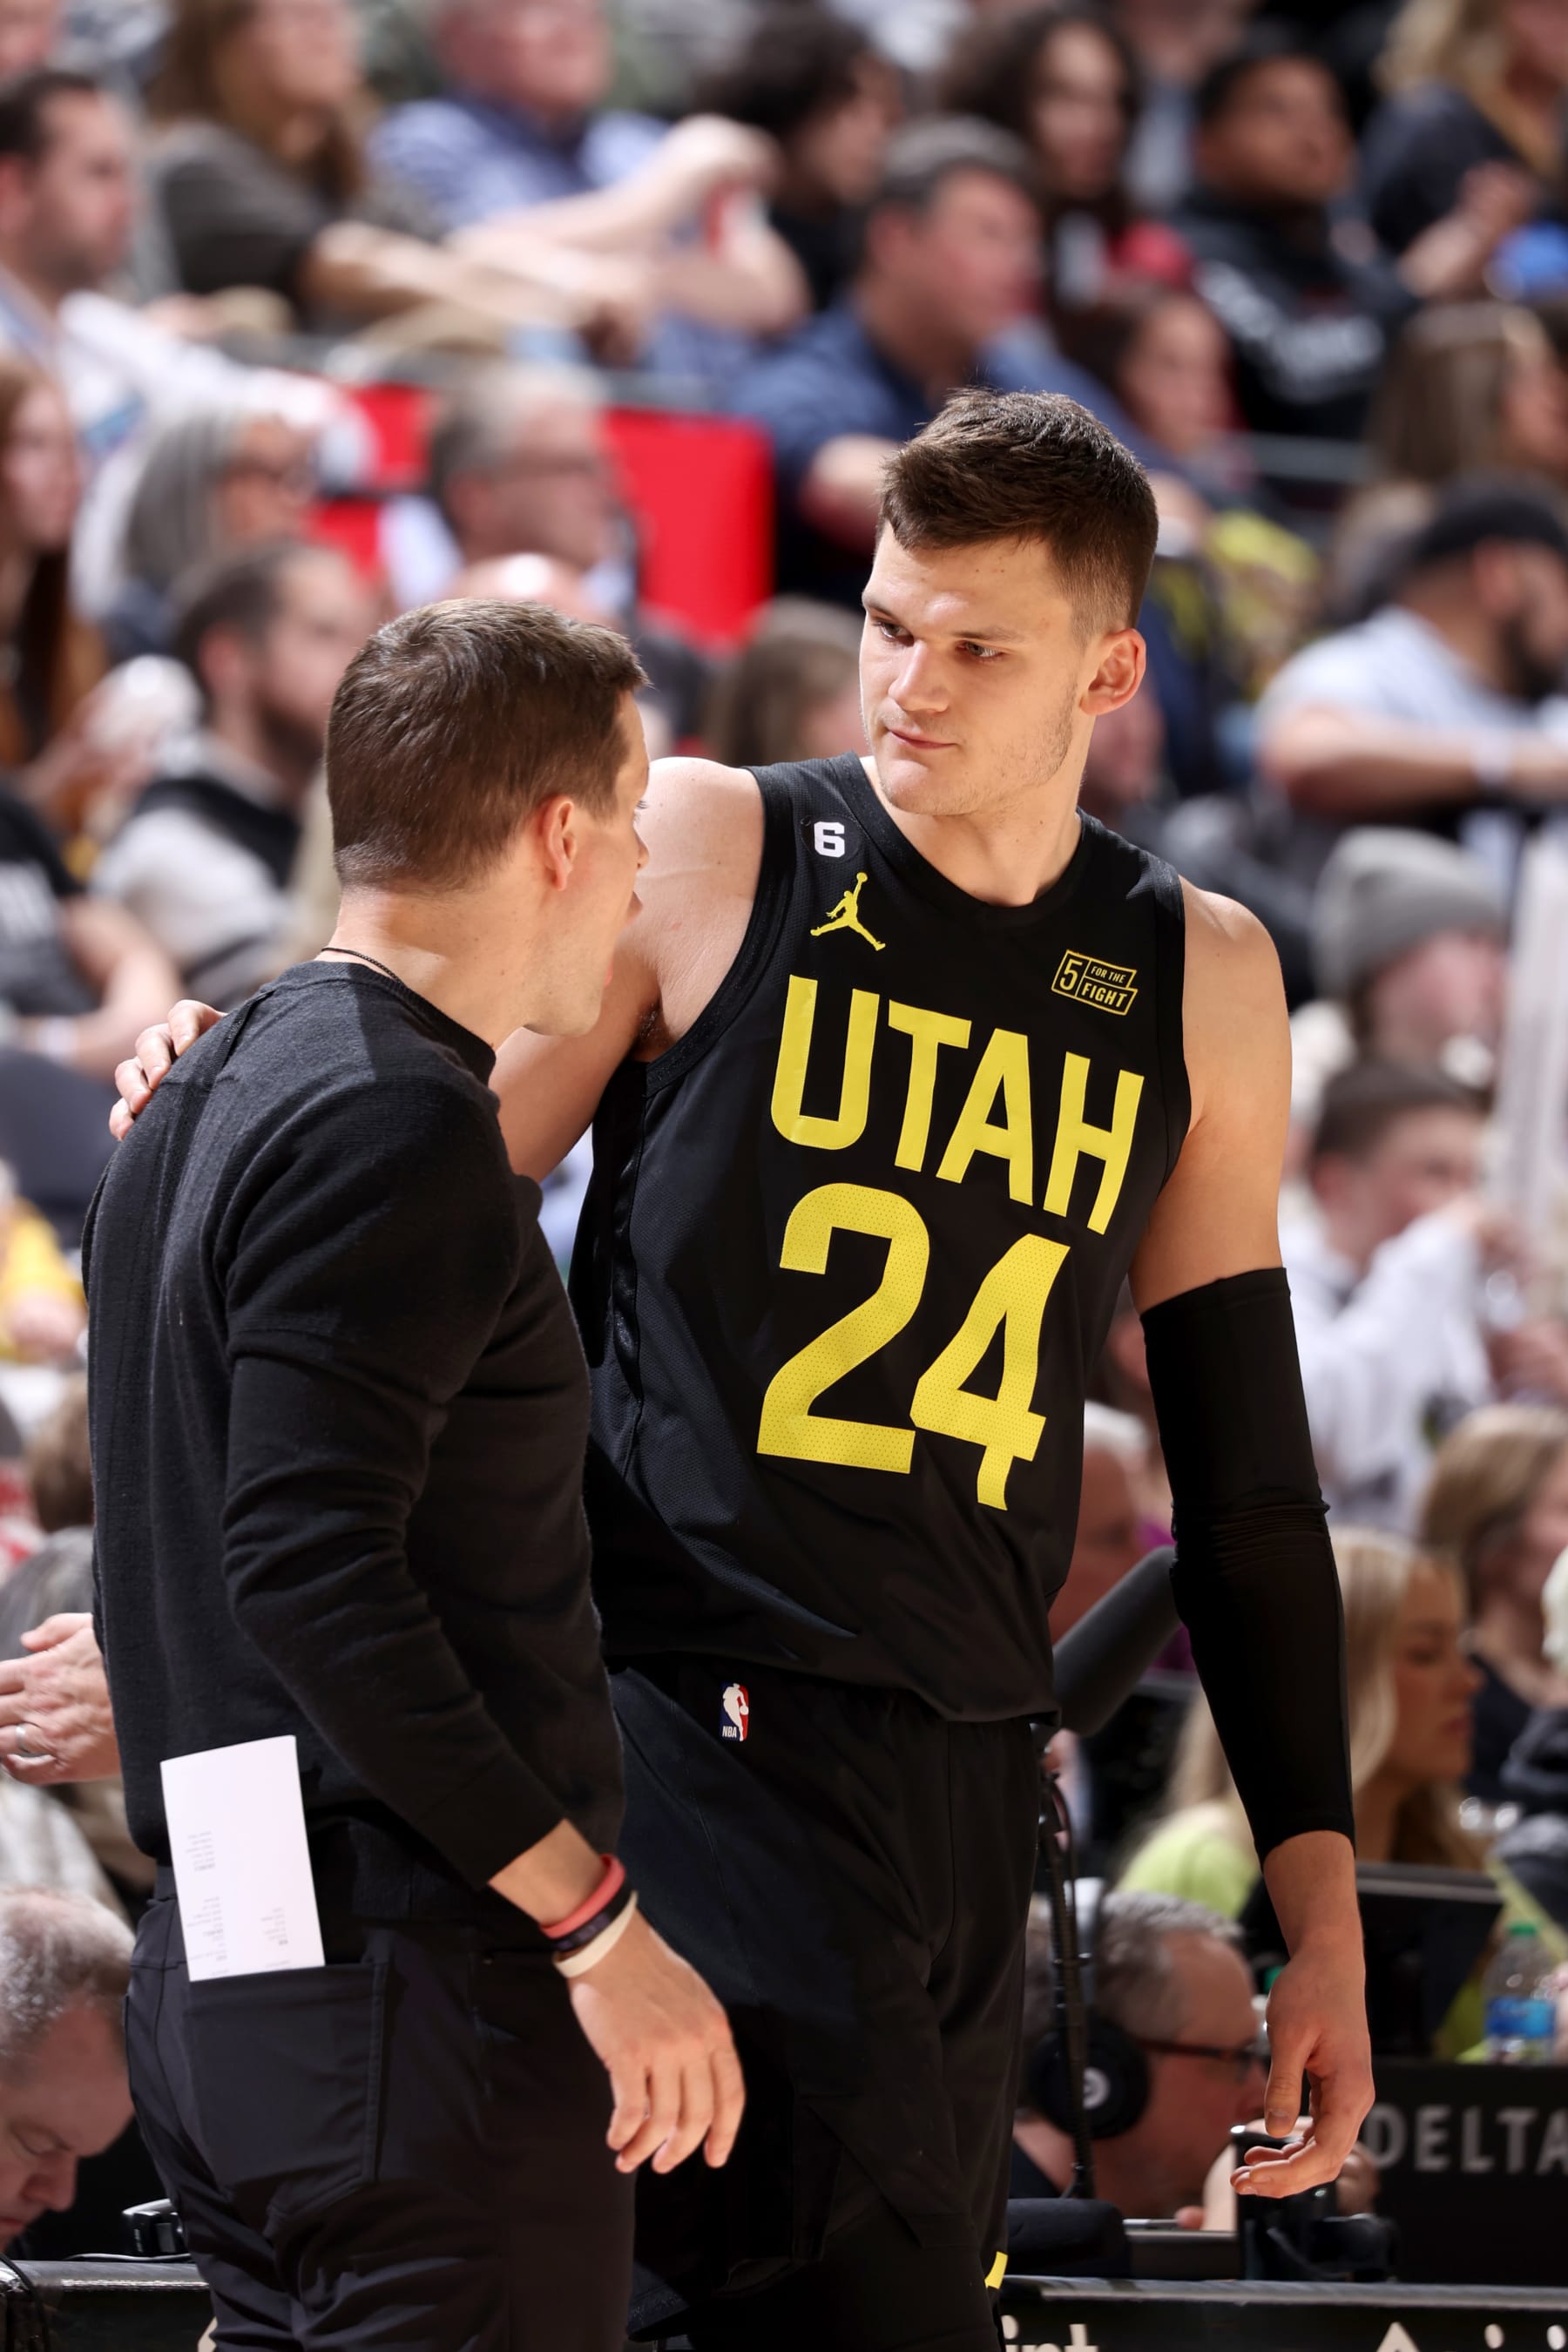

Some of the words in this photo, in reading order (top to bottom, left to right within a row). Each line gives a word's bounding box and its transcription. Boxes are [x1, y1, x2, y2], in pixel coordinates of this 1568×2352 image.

[814, 821, 845, 858] 6
[1059, 958, 1083, 990] 5
[1090, 966, 1108, 978] FOR
[1108, 971, 1127, 983] THE
[1081, 982, 1128, 1008] FIGHT
[771, 975, 1145, 1234] UTAH
[756, 1182, 1071, 1511] 24
[722, 1726, 737, 1739] NBA
